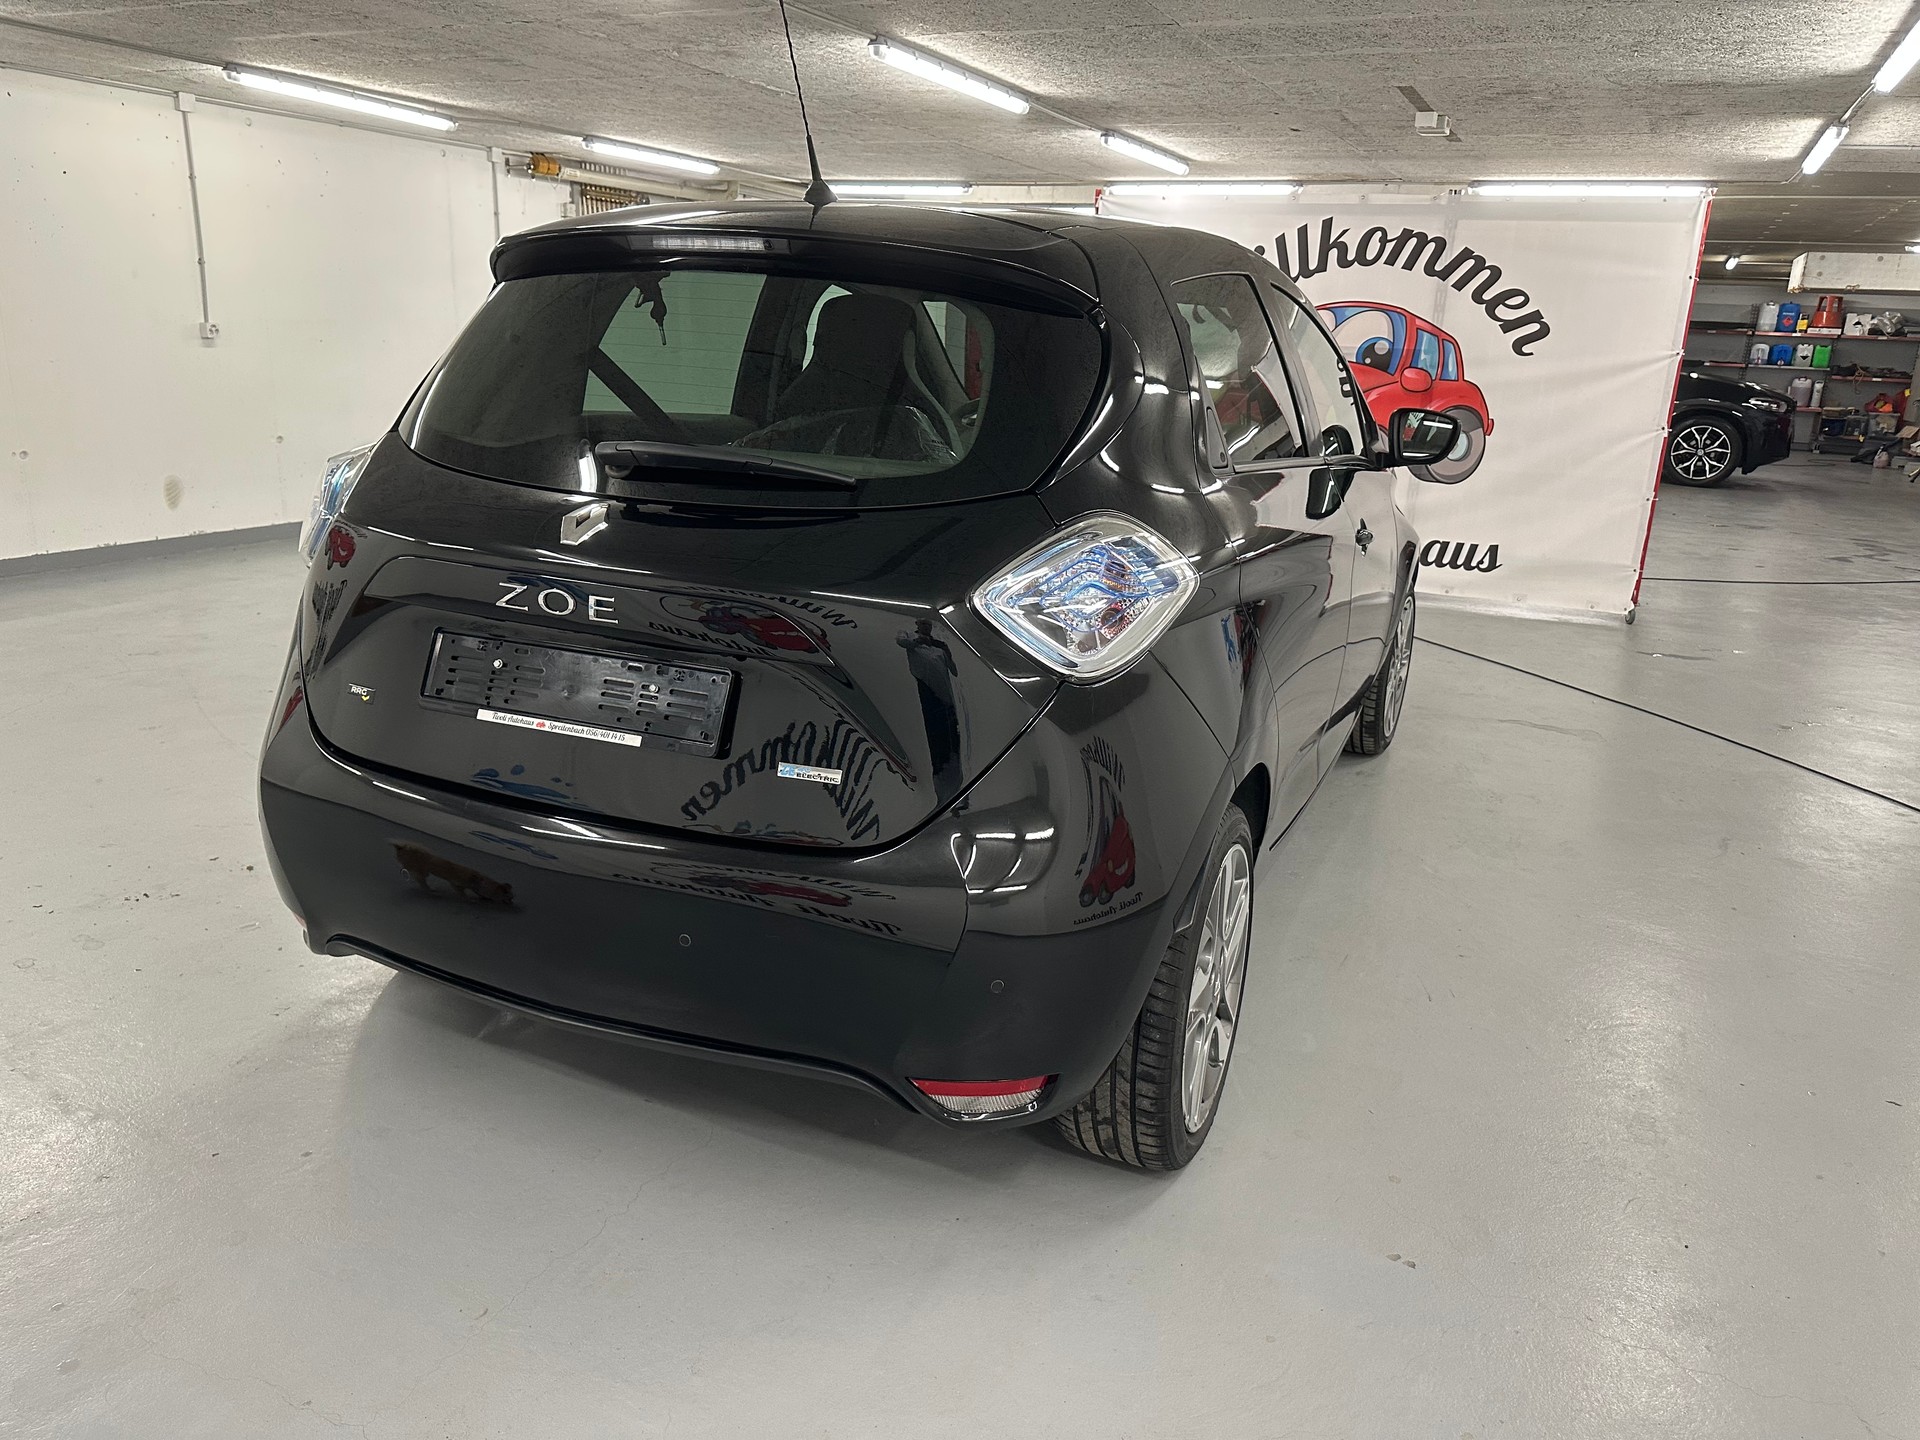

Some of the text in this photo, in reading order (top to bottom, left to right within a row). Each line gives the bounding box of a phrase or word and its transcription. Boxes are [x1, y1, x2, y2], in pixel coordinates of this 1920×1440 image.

[1253, 216, 1551, 357] llkommen
[1419, 540, 1503, 572] aus
[495, 582, 619, 624] ZOE
[507, 715, 535, 727] Autohaus
[796, 772, 840, 784] ELECTRIC
